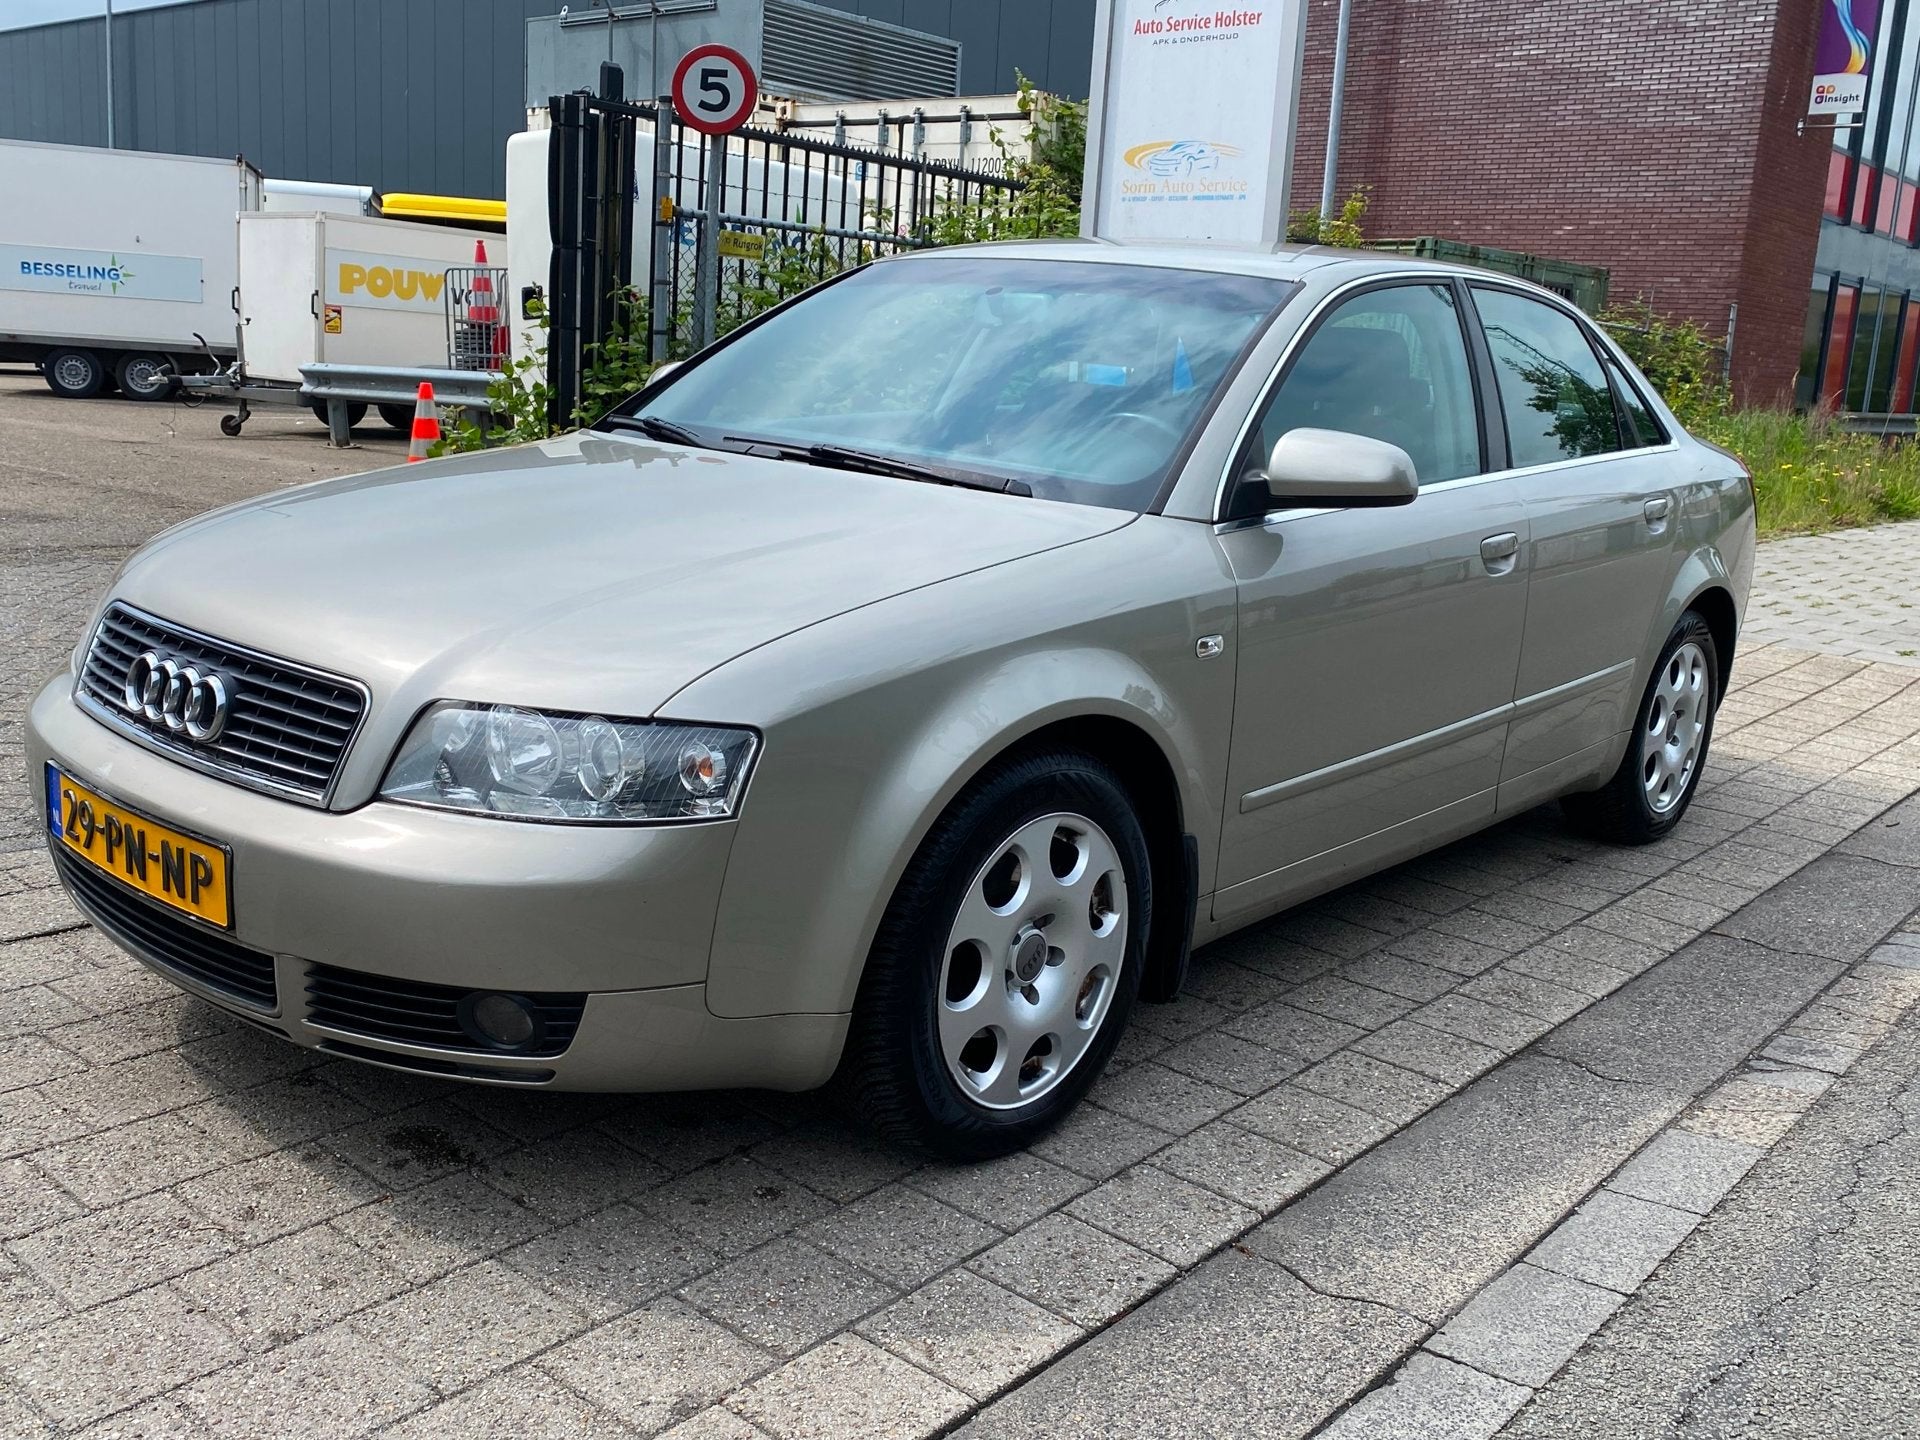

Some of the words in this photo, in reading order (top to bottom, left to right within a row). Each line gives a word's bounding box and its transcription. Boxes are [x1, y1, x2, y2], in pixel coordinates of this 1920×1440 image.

[1134, 19, 1163, 35] Auto
[1166, 14, 1211, 32] Service
[1215, 10, 1263, 28] Holster
[1152, 38, 1170, 46] APK
[1180, 33, 1239, 43] ONDERHOUD
[698, 68, 731, 112] 5
[1824, 93, 1860, 104] Insight
[1122, 179, 1156, 194] Sorin
[1161, 178, 1194, 193] Auto
[1200, 177, 1248, 192] Service
[20, 261, 120, 281] BESSELING
[68, 280, 102, 291] travel
[339, 263, 446, 302] POUW
[52, 807, 62, 826] NL
[63, 788, 213, 905] 29-PN-NP
